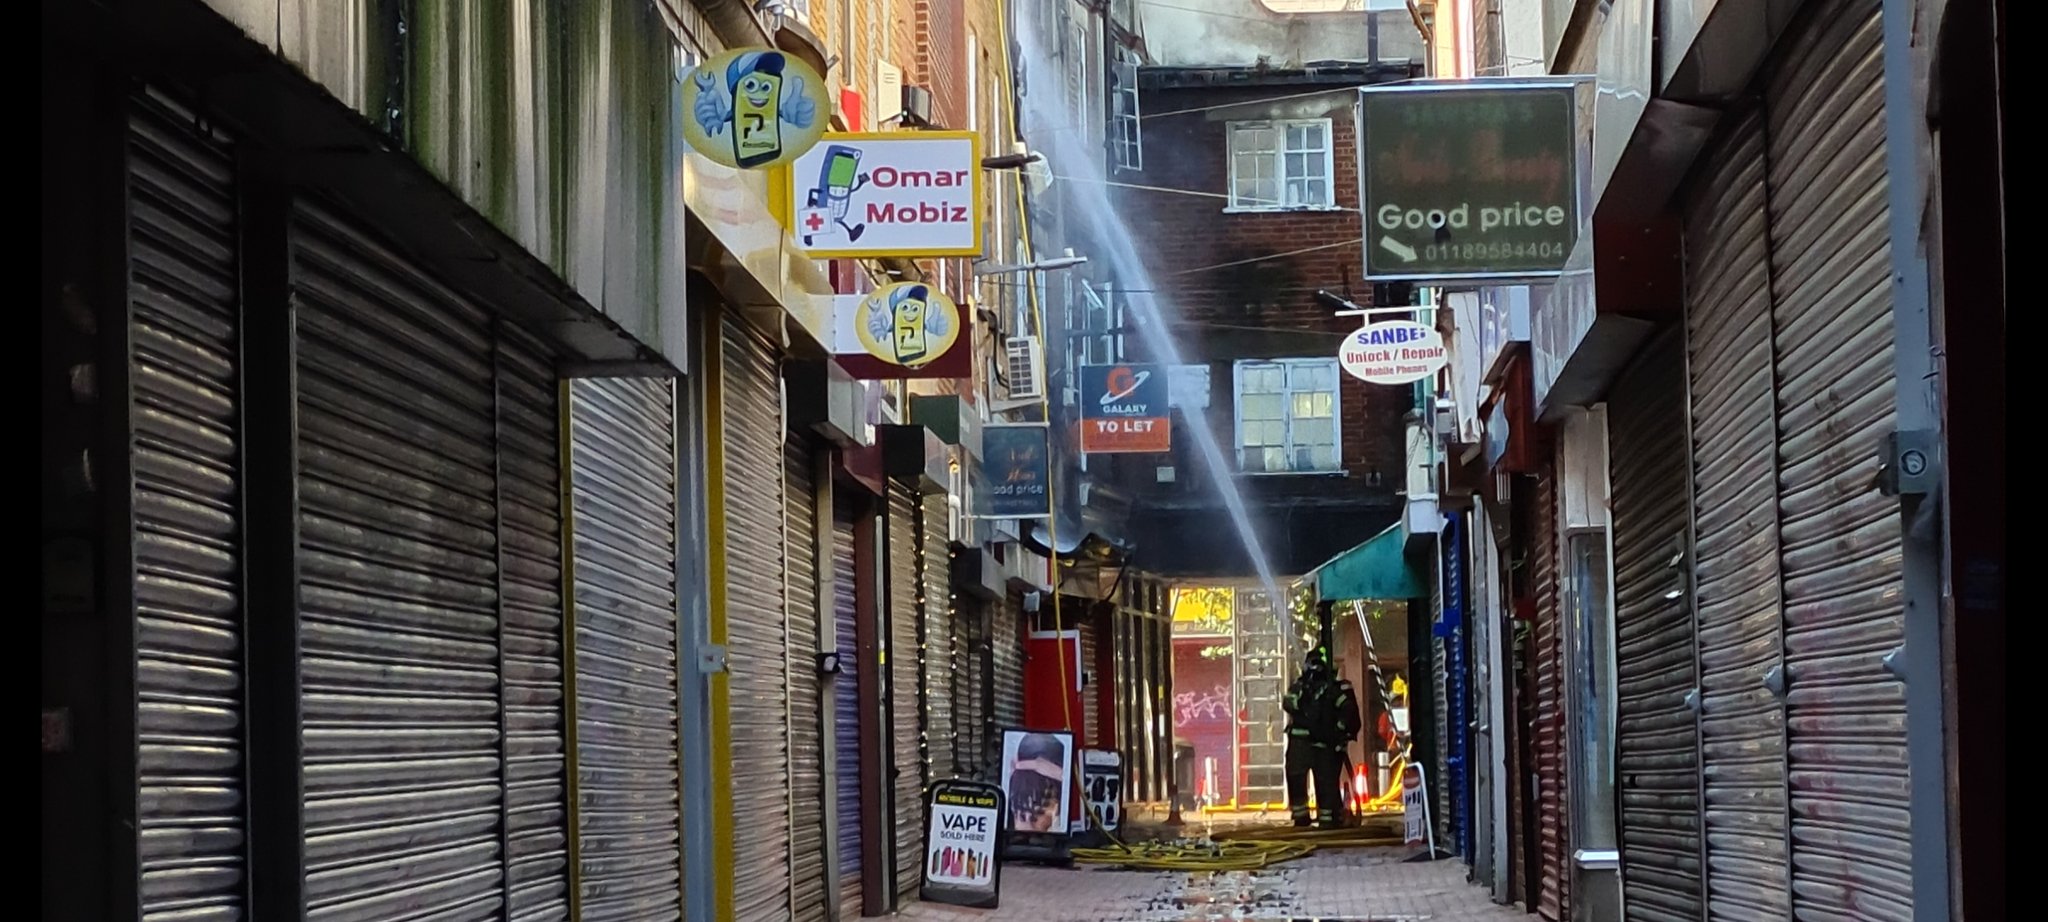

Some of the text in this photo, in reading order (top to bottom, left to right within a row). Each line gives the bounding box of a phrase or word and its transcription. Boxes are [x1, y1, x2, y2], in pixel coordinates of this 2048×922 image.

[872, 166, 968, 188] Omar
[867, 200, 968, 223] Mobiz
[1377, 201, 1565, 232] Good price
[1425, 242, 1563, 261] 01189584404
[1347, 350, 1391, 364] Unlock
[1401, 346, 1444, 361] Repair
[1365, 364, 1428, 376] Mobile Phones
[1097, 420, 1154, 433] TO LET
[1016, 484, 1043, 496] price
[941, 813, 988, 833] VAPE
[940, 831, 985, 842] SOLD HERE
